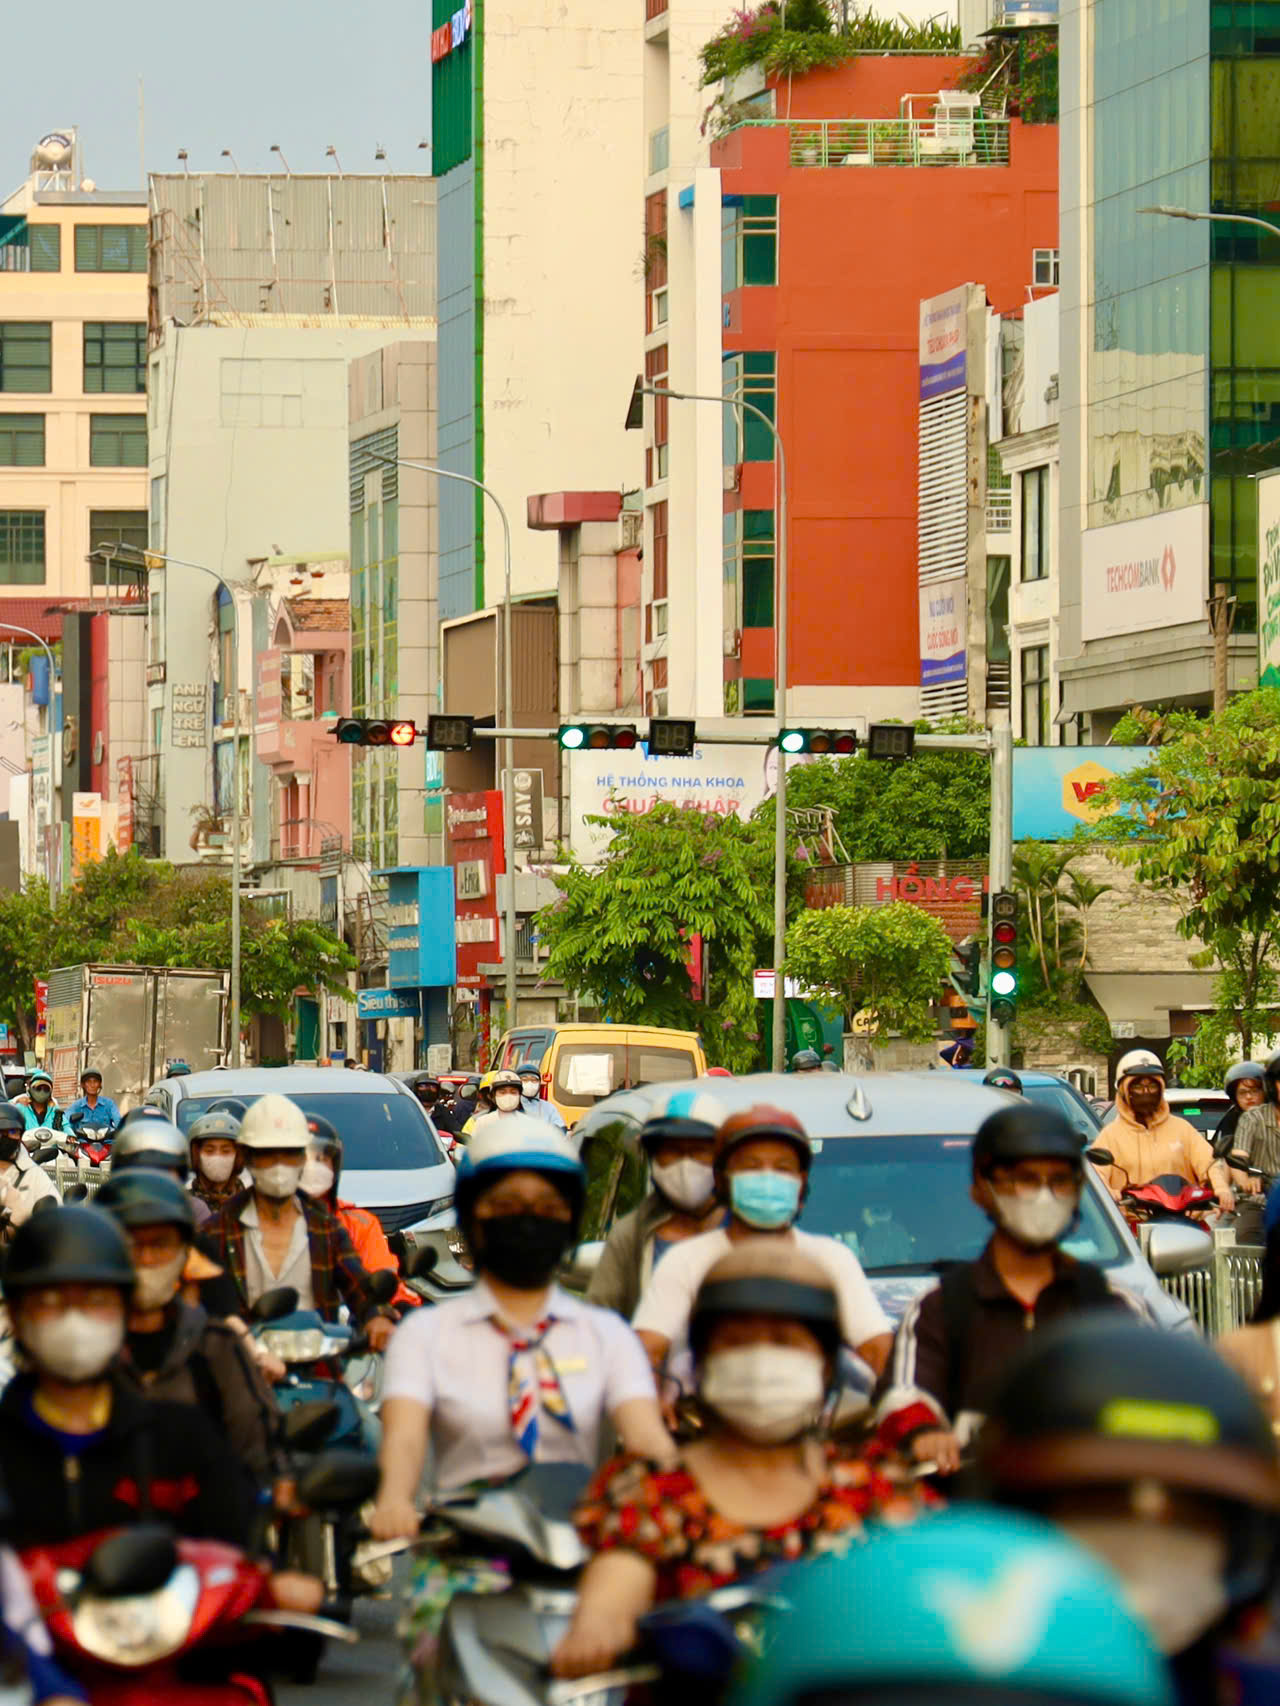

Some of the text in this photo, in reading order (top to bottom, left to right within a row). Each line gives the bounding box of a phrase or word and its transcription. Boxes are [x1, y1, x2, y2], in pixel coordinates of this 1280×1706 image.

[1106, 557, 1160, 593] TECHCOMBANK
[175, 683, 205, 696] ANH
[180, 736, 200, 747] EM
[618, 770, 668, 788] THỐNG
[671, 776, 702, 788] NHA
[705, 776, 745, 788] KHOA
[515, 792, 532, 826] SAY
[93, 976, 132, 985] ISUZU
